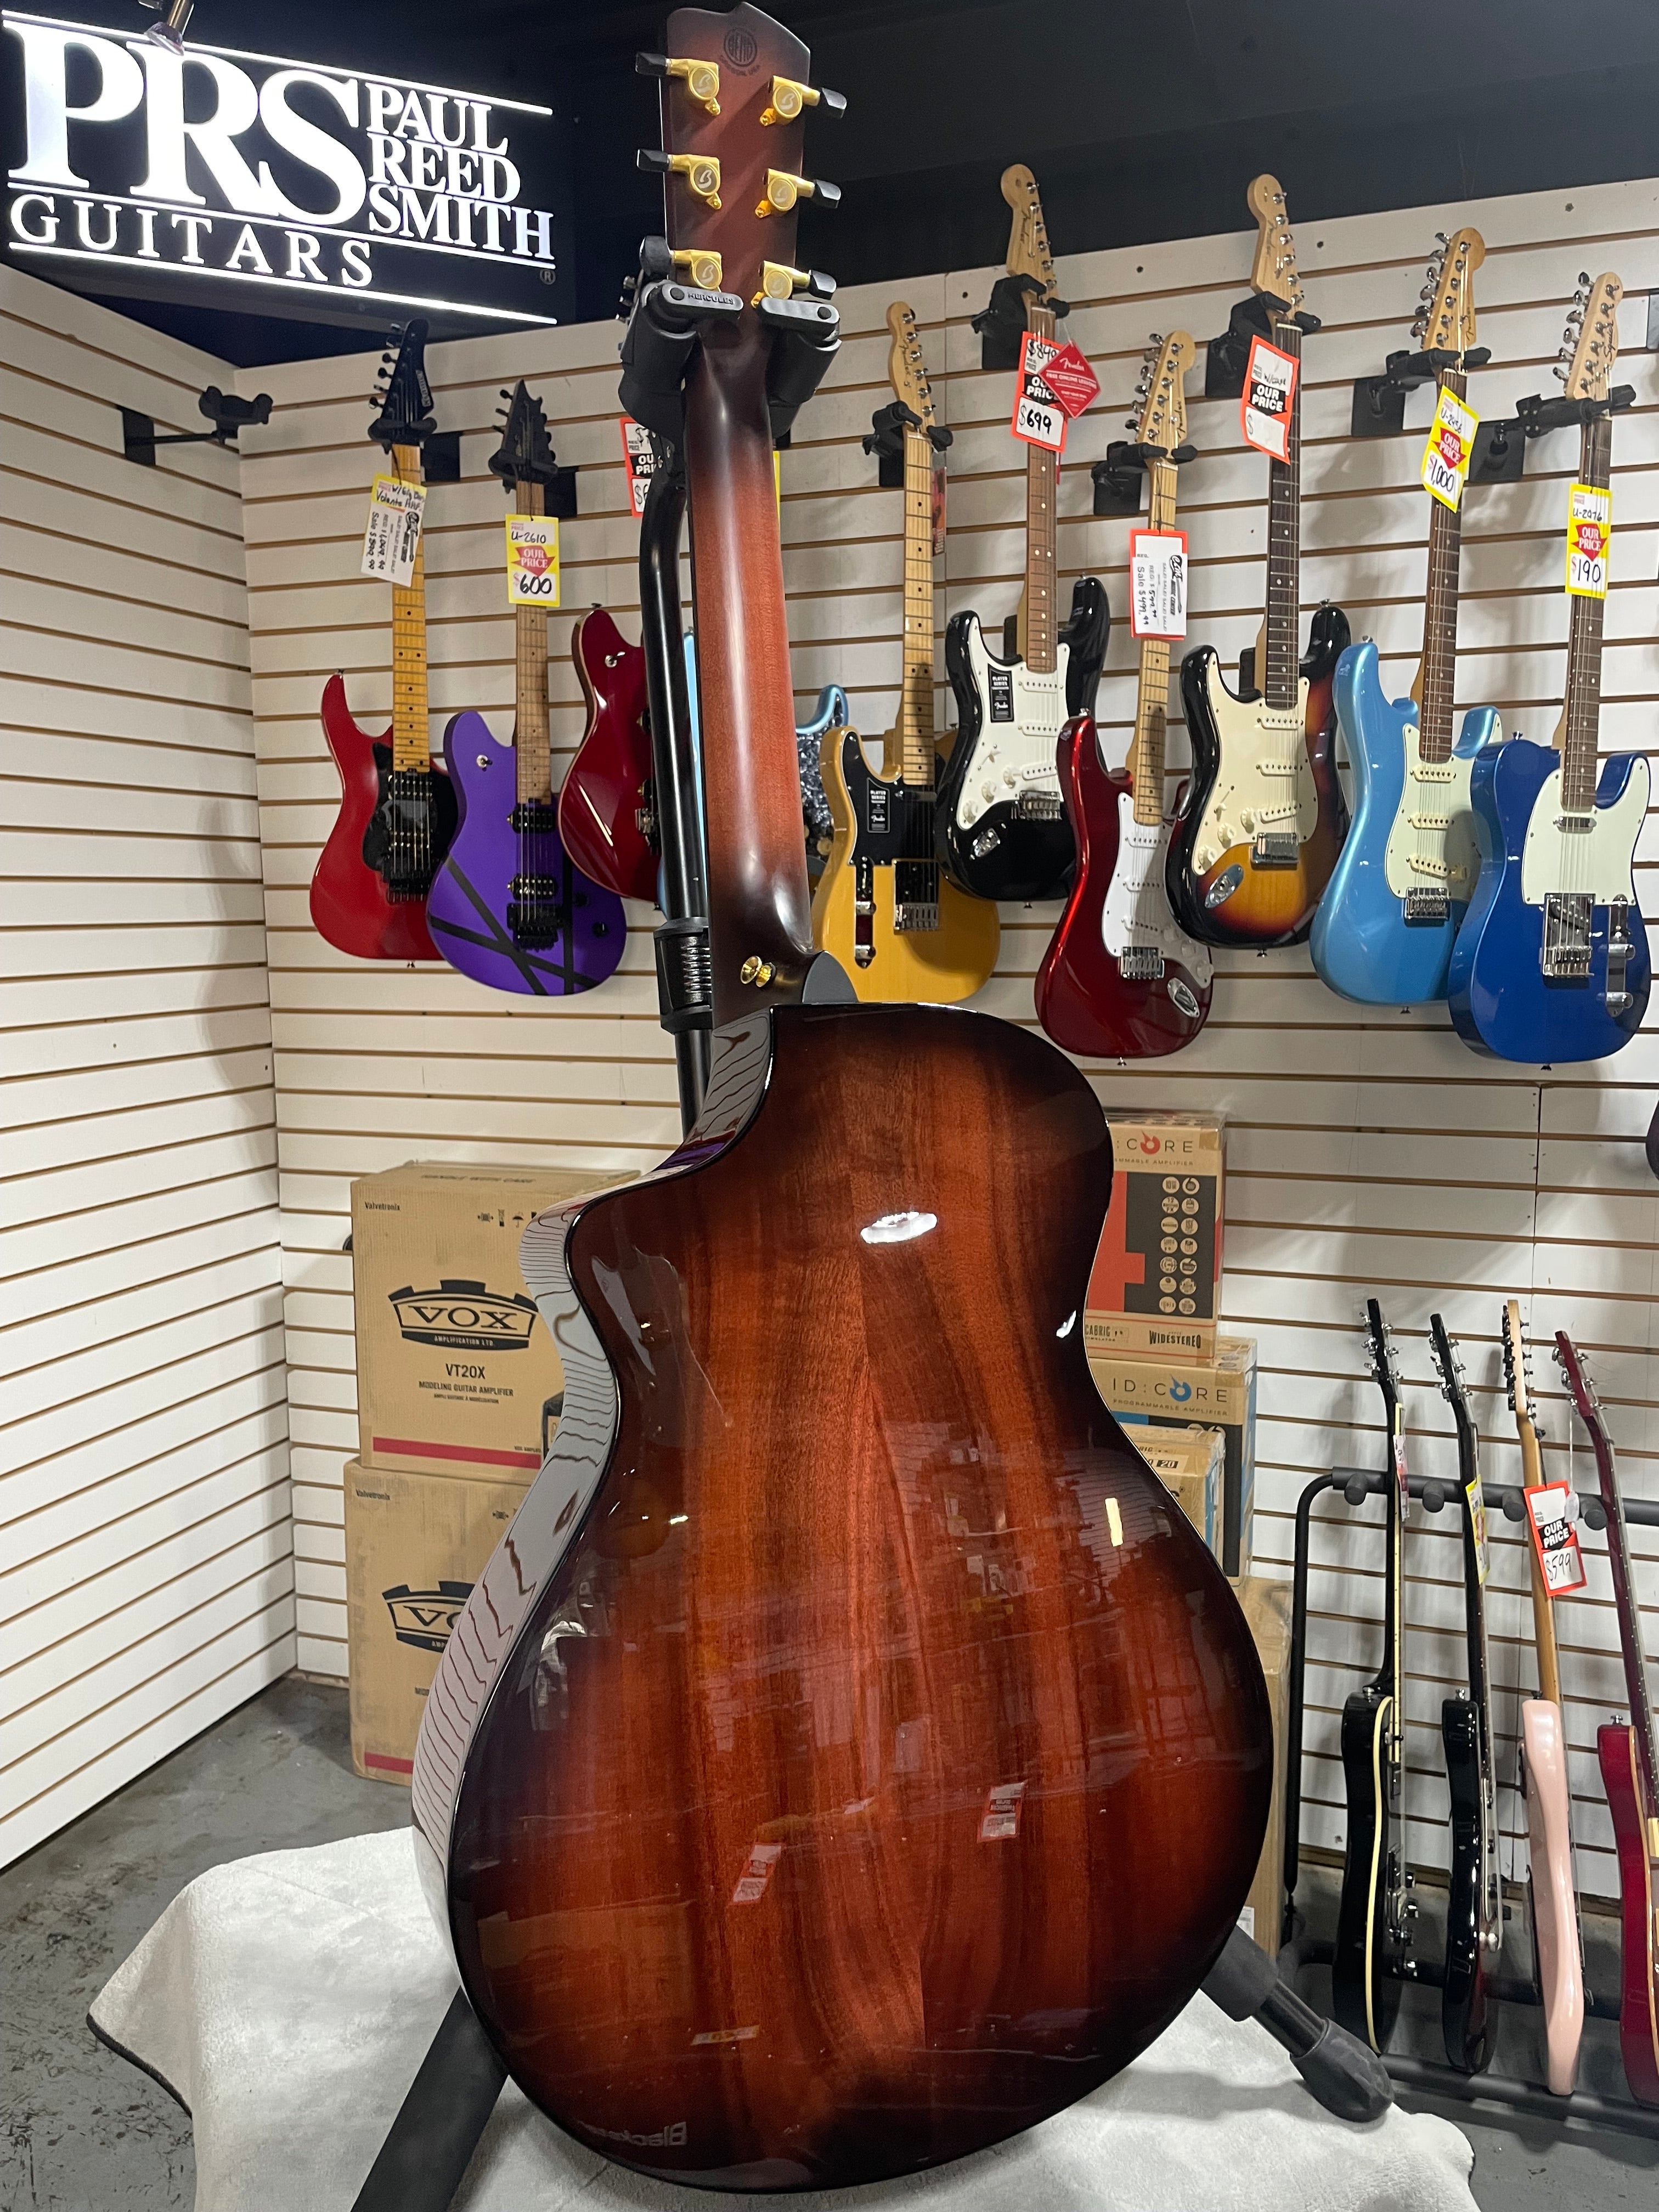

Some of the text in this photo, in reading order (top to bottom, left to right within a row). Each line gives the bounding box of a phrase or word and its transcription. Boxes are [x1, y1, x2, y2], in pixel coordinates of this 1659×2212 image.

[3, 20, 367, 225] PRS
[366, 82, 509, 155] PAUL
[368, 133, 521, 205] REED
[369, 184, 555, 260] SMITH
[9, 193, 374, 287] GUITARS
[688, 292, 734, 305] HERCULES
[1031, 376, 1047, 388] OU
[1256, 385, 1279, 399] OUR
[1251, 394, 1284, 412] PRICE
[1019, 404, 1052, 435] $699
[1444, 433, 1460, 450] OUR
[638, 455, 654, 465] OU
[1440, 442, 1460, 464] PRICE
[635, 464, 657, 475] PRI
[511, 531, 546, 544] U-2610
[1582, 527, 1599, 539] OUR
[1579, 538, 1601, 551] PRICE
[523, 549, 544, 558] OUR
[521, 557, 548, 568] PRICE
[1571, 556, 1601, 583] $190
[513, 572, 552, 595] $600
[1116, 1130, 1193, 1155] :CORE
[364, 1201, 401, 1211] Valvetronix
[408, 1305, 518, 1330] VOX
[434, 1335, 479, 1345] AMPLIFICATION
[1149, 1330, 1201, 1349] WIDESTEREO
[445, 1363, 486, 1379] VT20X
[419, 1381, 514, 1397] MODELING GUITAR AMPLIFIER
[1113, 1399, 1228, 1416] PROGRAMMABLE AMPLIFIER
[356, 1488, 391, 1501] Valvetronix
[1544, 1520, 1563, 1537] OUR
[1543, 1530, 1570, 1549] PRICE
[1545, 1553, 1572, 1582] $599
